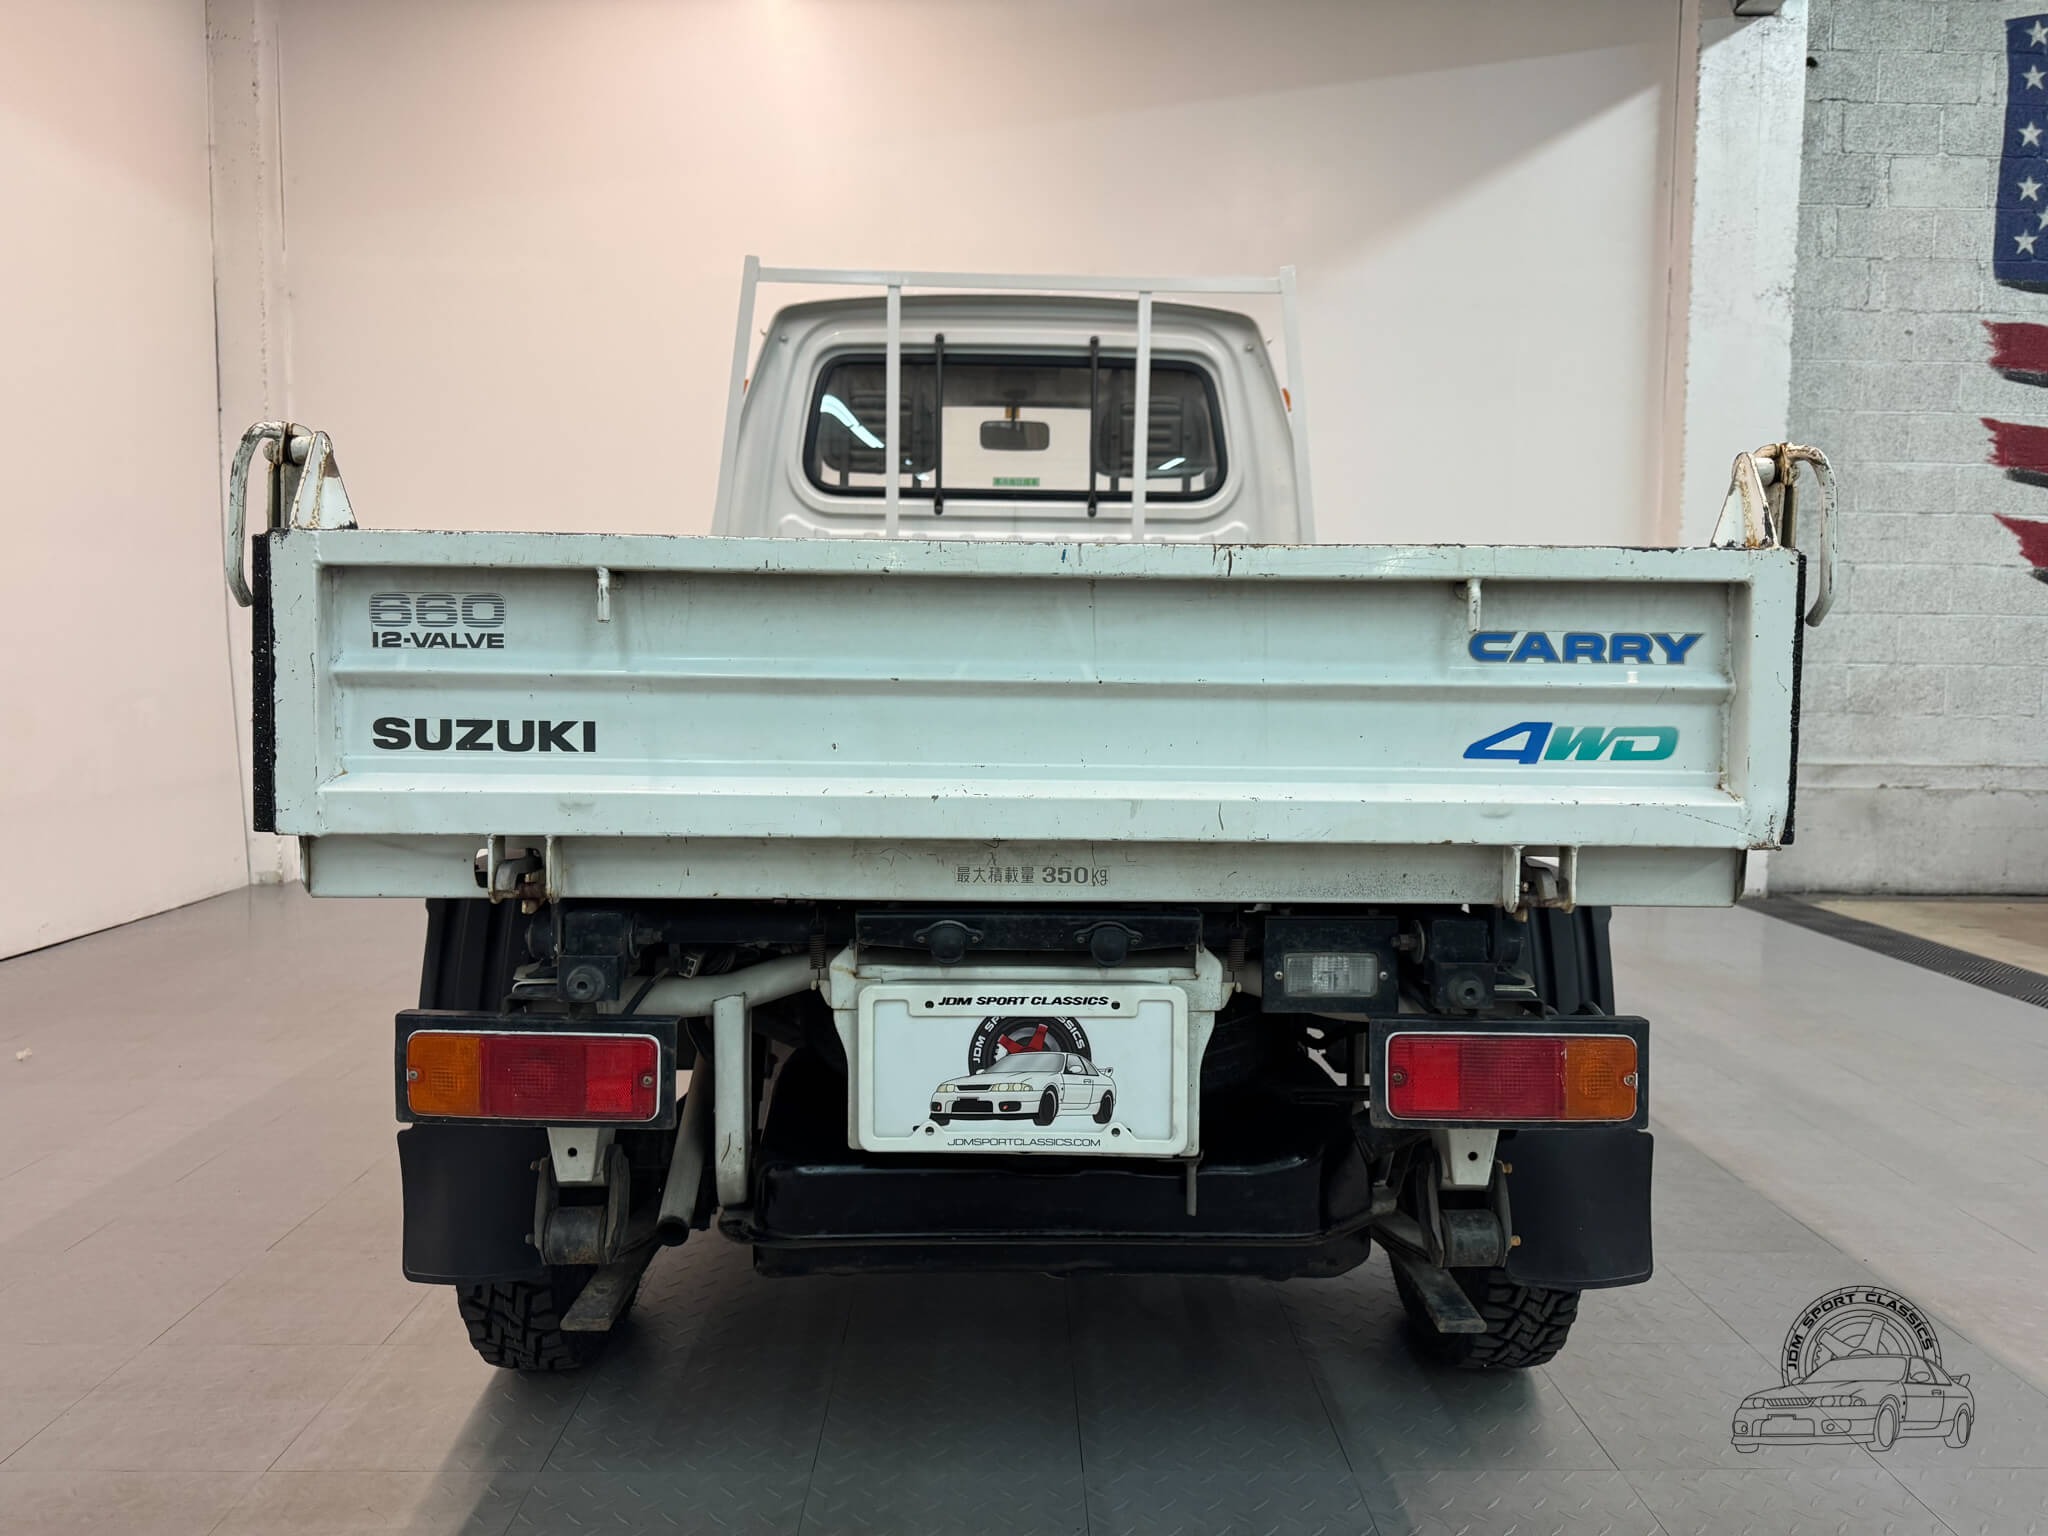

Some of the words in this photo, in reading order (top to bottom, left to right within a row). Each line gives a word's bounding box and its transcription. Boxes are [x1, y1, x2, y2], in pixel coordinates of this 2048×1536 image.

[370, 593, 505, 628] 660
[373, 631, 505, 649] 12-VALVE
[1468, 631, 1704, 665] CARRY
[372, 717, 596, 753] SUZUKI
[1463, 721, 1679, 764] 4WD
[957, 866, 1035, 884] 最大積載量
[938, 996, 973, 1006] JDM
[976, 996, 1029, 1006] SPORT
[1030, 996, 1109, 1006] CLASSICS
[972, 1035, 986, 1063] JDM
[947, 1137, 1101, 1148] JDMSPORTCLASSICS.COM
